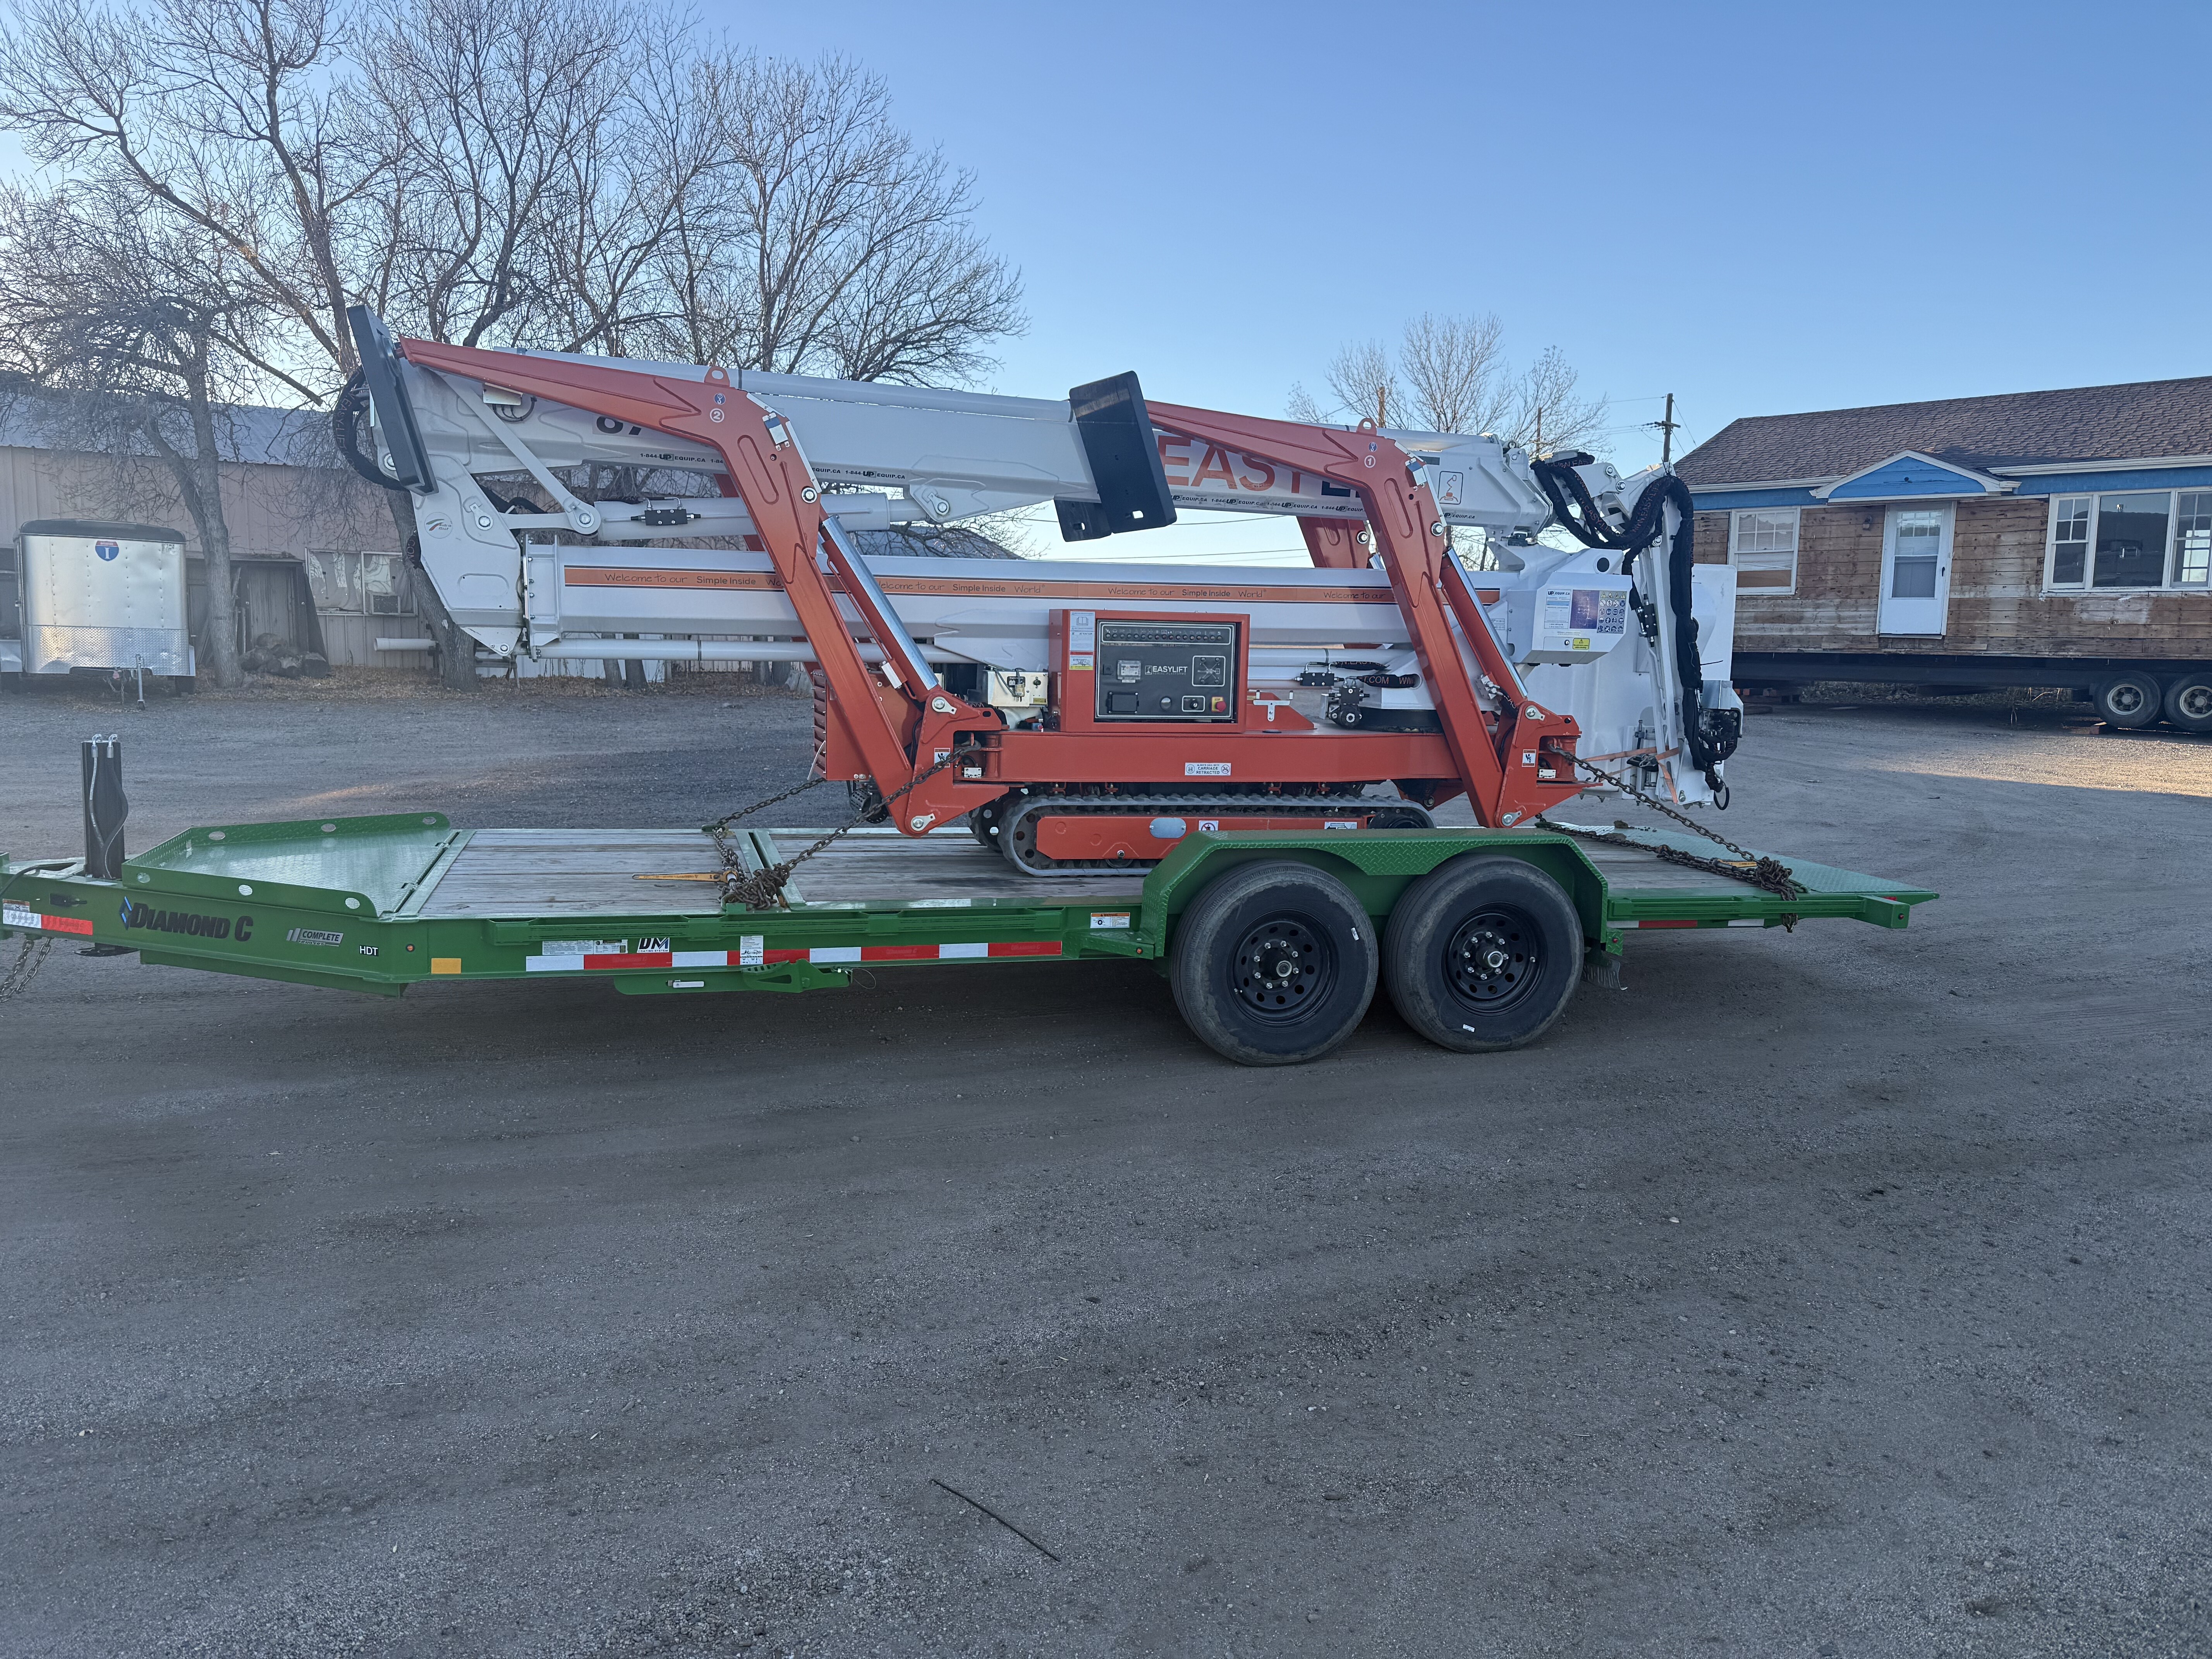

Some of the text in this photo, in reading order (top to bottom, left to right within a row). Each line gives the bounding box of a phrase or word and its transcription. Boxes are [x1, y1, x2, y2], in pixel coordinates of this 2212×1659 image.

[713, 410, 721, 420] 2
[605, 573, 652, 582] Welcome
[654, 573, 666, 582] to
[697, 576, 728, 586] Simple
[879, 580, 913, 589] elcome
[915, 581, 926, 590] to
[953, 584, 981, 592] Simple
[1108, 587, 1146, 595] Welcome
[1182, 589, 1207, 597] Simple
[1323, 591, 1359, 599] Welcome
[130, 902, 254, 942] DIAMOND C
[302, 930, 340, 942] COMPLETE
[639, 937, 669, 949] DM
[359, 945, 378, 956] HDT
